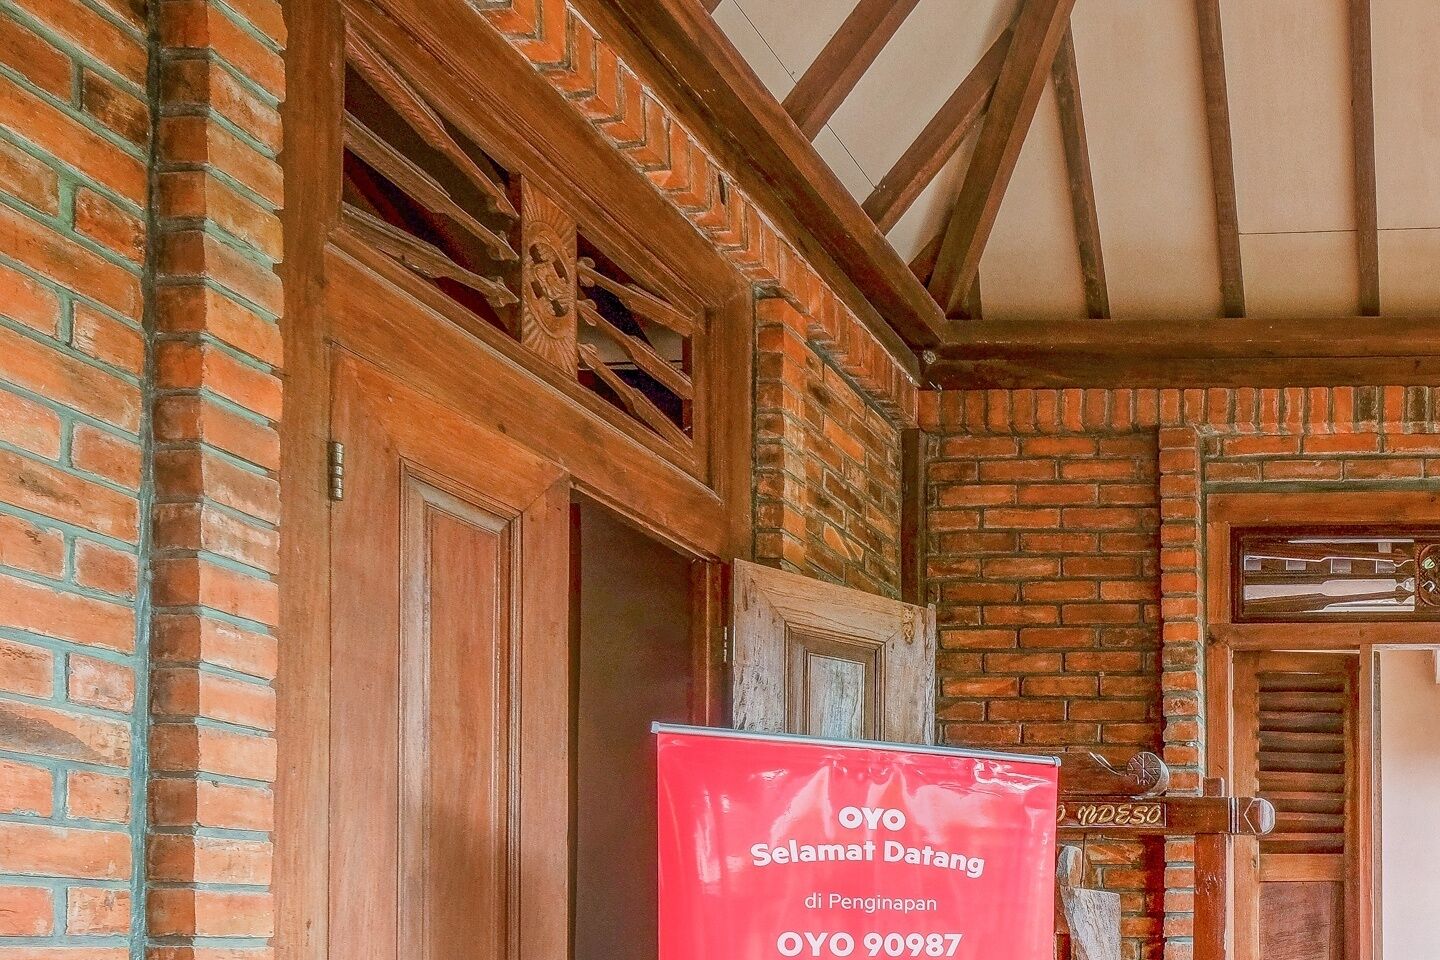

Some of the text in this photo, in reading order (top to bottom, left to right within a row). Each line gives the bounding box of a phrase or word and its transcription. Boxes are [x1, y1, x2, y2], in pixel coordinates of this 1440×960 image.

[838, 806, 907, 832] OYO
[1077, 803, 1162, 826] NDESO
[750, 838, 985, 879] Selamat Datang
[805, 892, 937, 914] di Penginapan
[776, 931, 963, 957] OYO 90987
